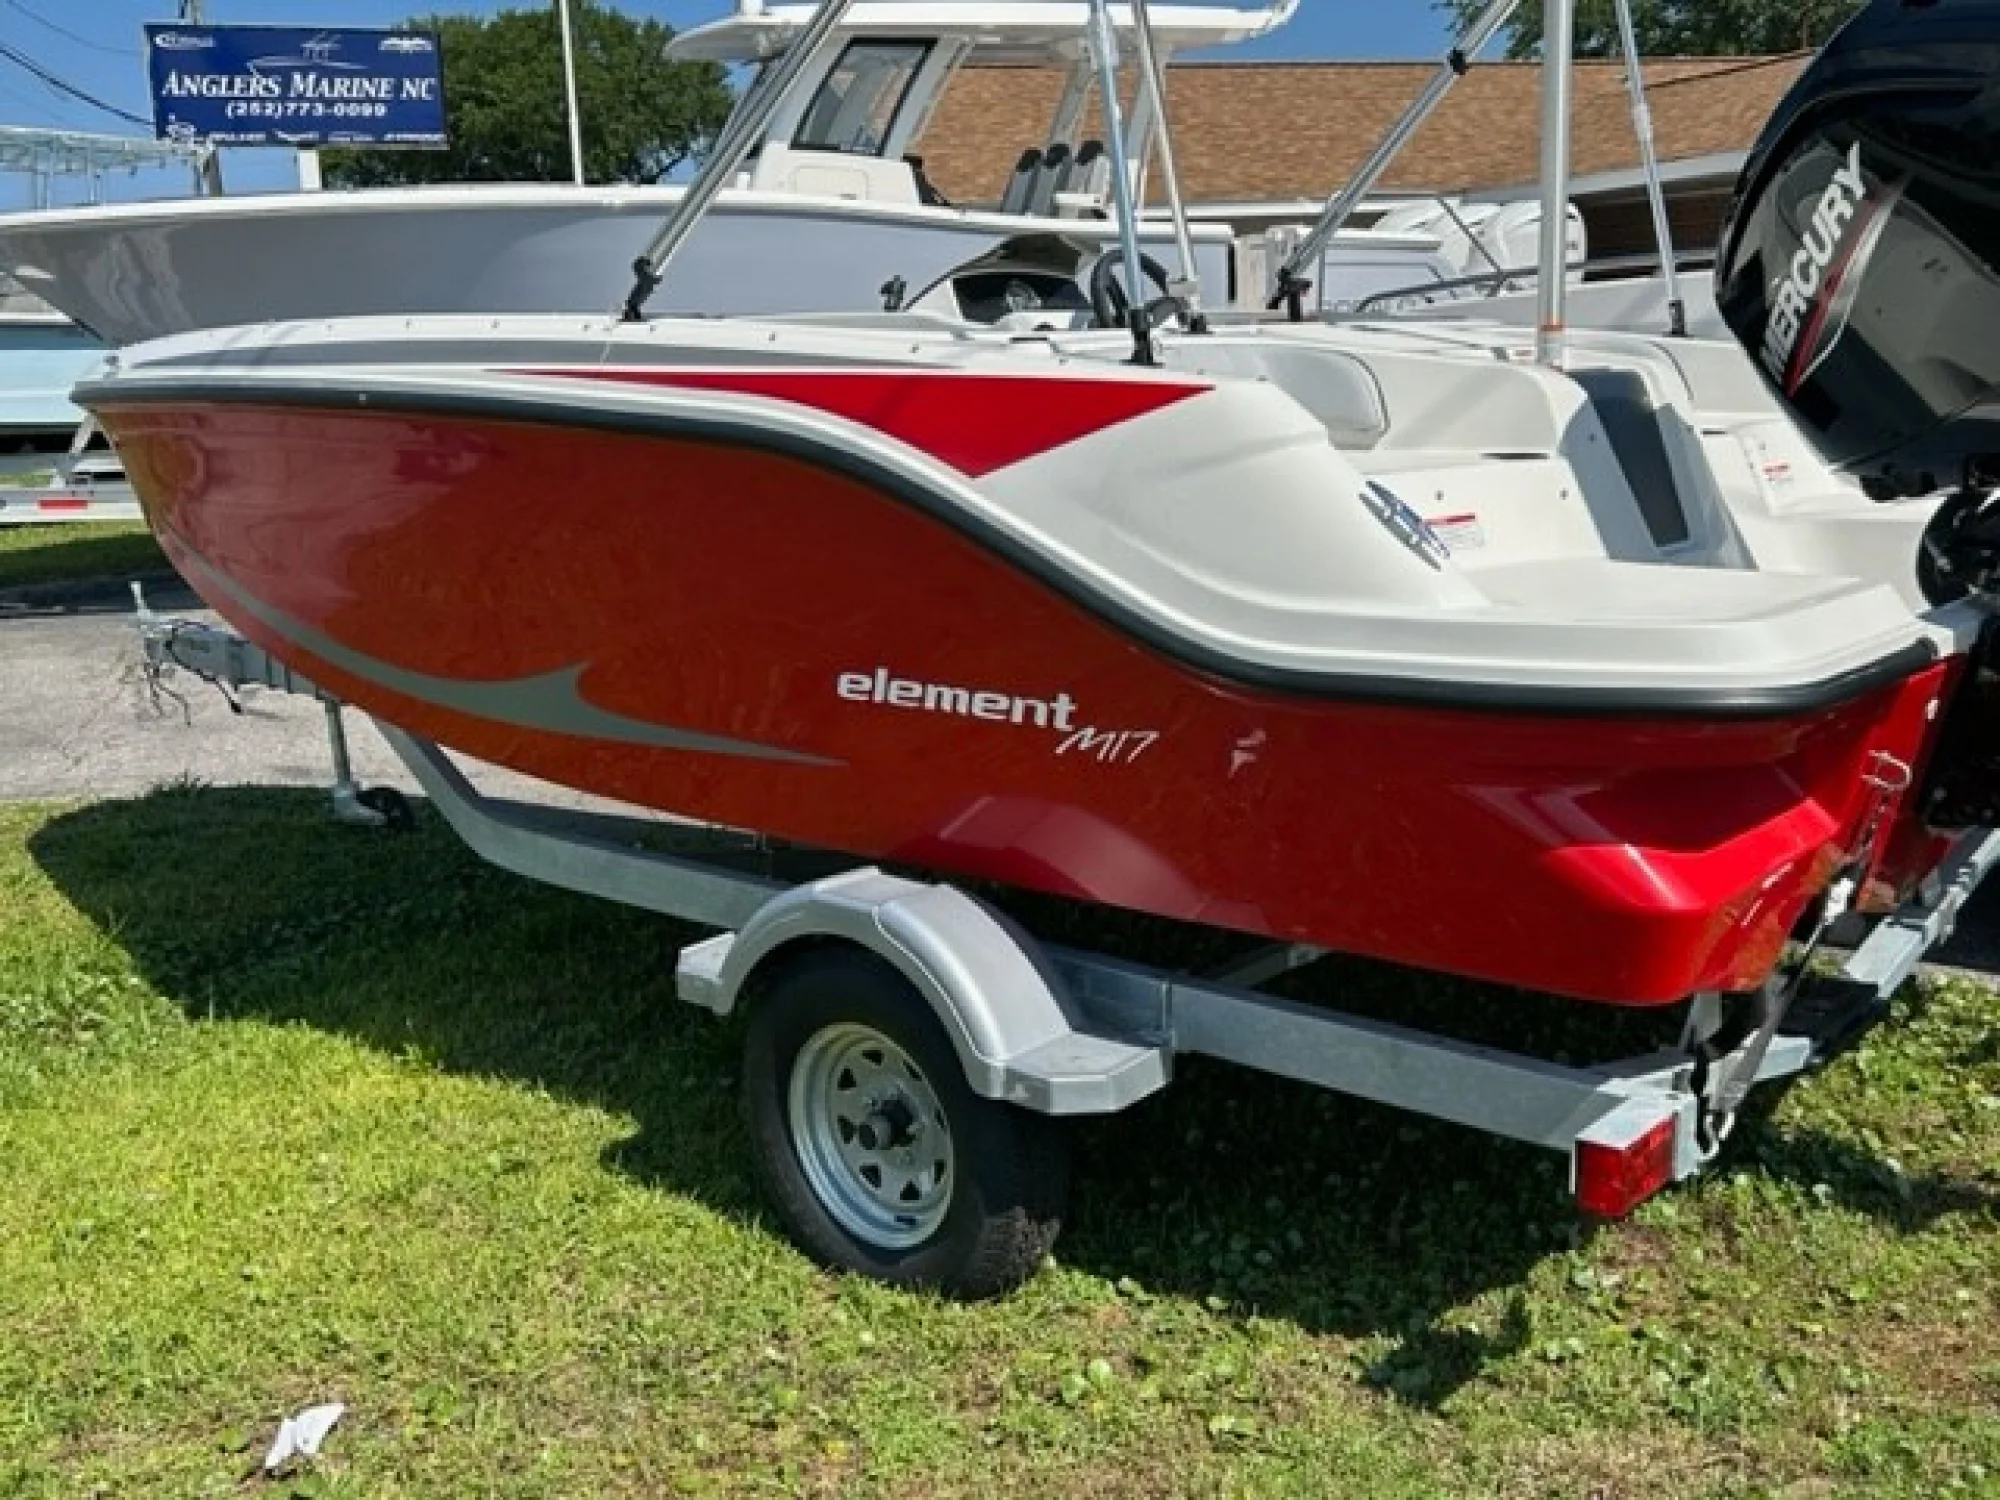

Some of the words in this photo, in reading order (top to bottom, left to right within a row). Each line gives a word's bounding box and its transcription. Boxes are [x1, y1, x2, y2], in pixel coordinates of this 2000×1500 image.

[161, 69, 281, 98] ANGLERS
[288, 71, 395, 99] MARINE
[400, 77, 437, 100] NC
[1759, 140, 1866, 384] MERCURY
[836, 667, 1077, 732] element
[1054, 726, 1159, 763] M17
